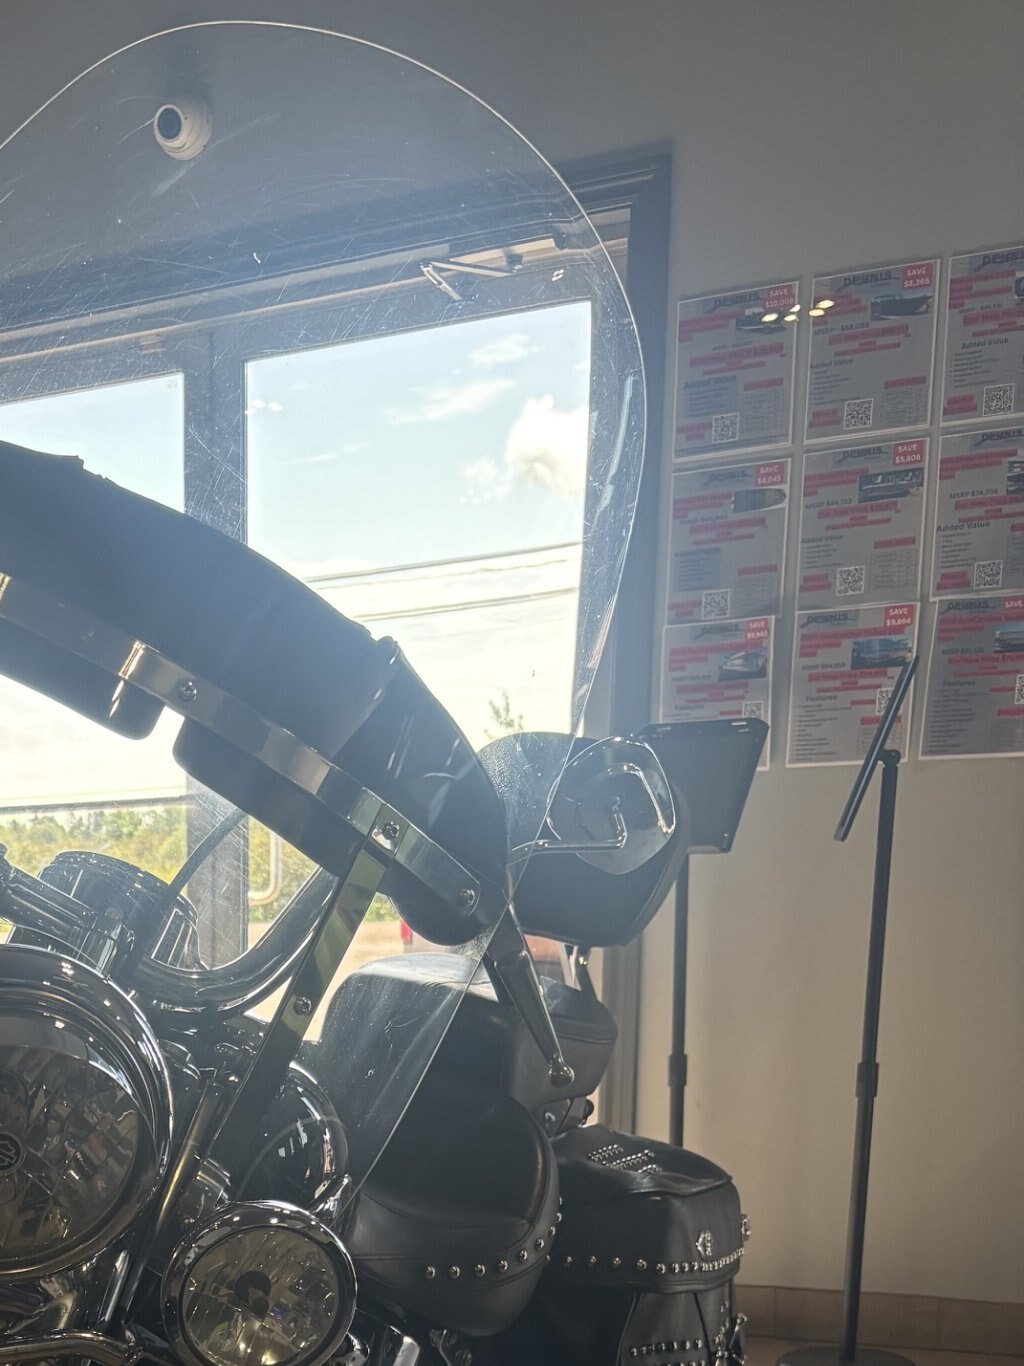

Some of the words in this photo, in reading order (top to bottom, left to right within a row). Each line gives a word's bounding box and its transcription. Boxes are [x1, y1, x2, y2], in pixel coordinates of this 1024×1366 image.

[906, 266, 928, 276] SAVE
[768, 287, 789, 298] SAVE
[898, 444, 919, 453] SAVE
[759, 465, 780, 474] SAVE
[888, 607, 909, 616] SAVE
